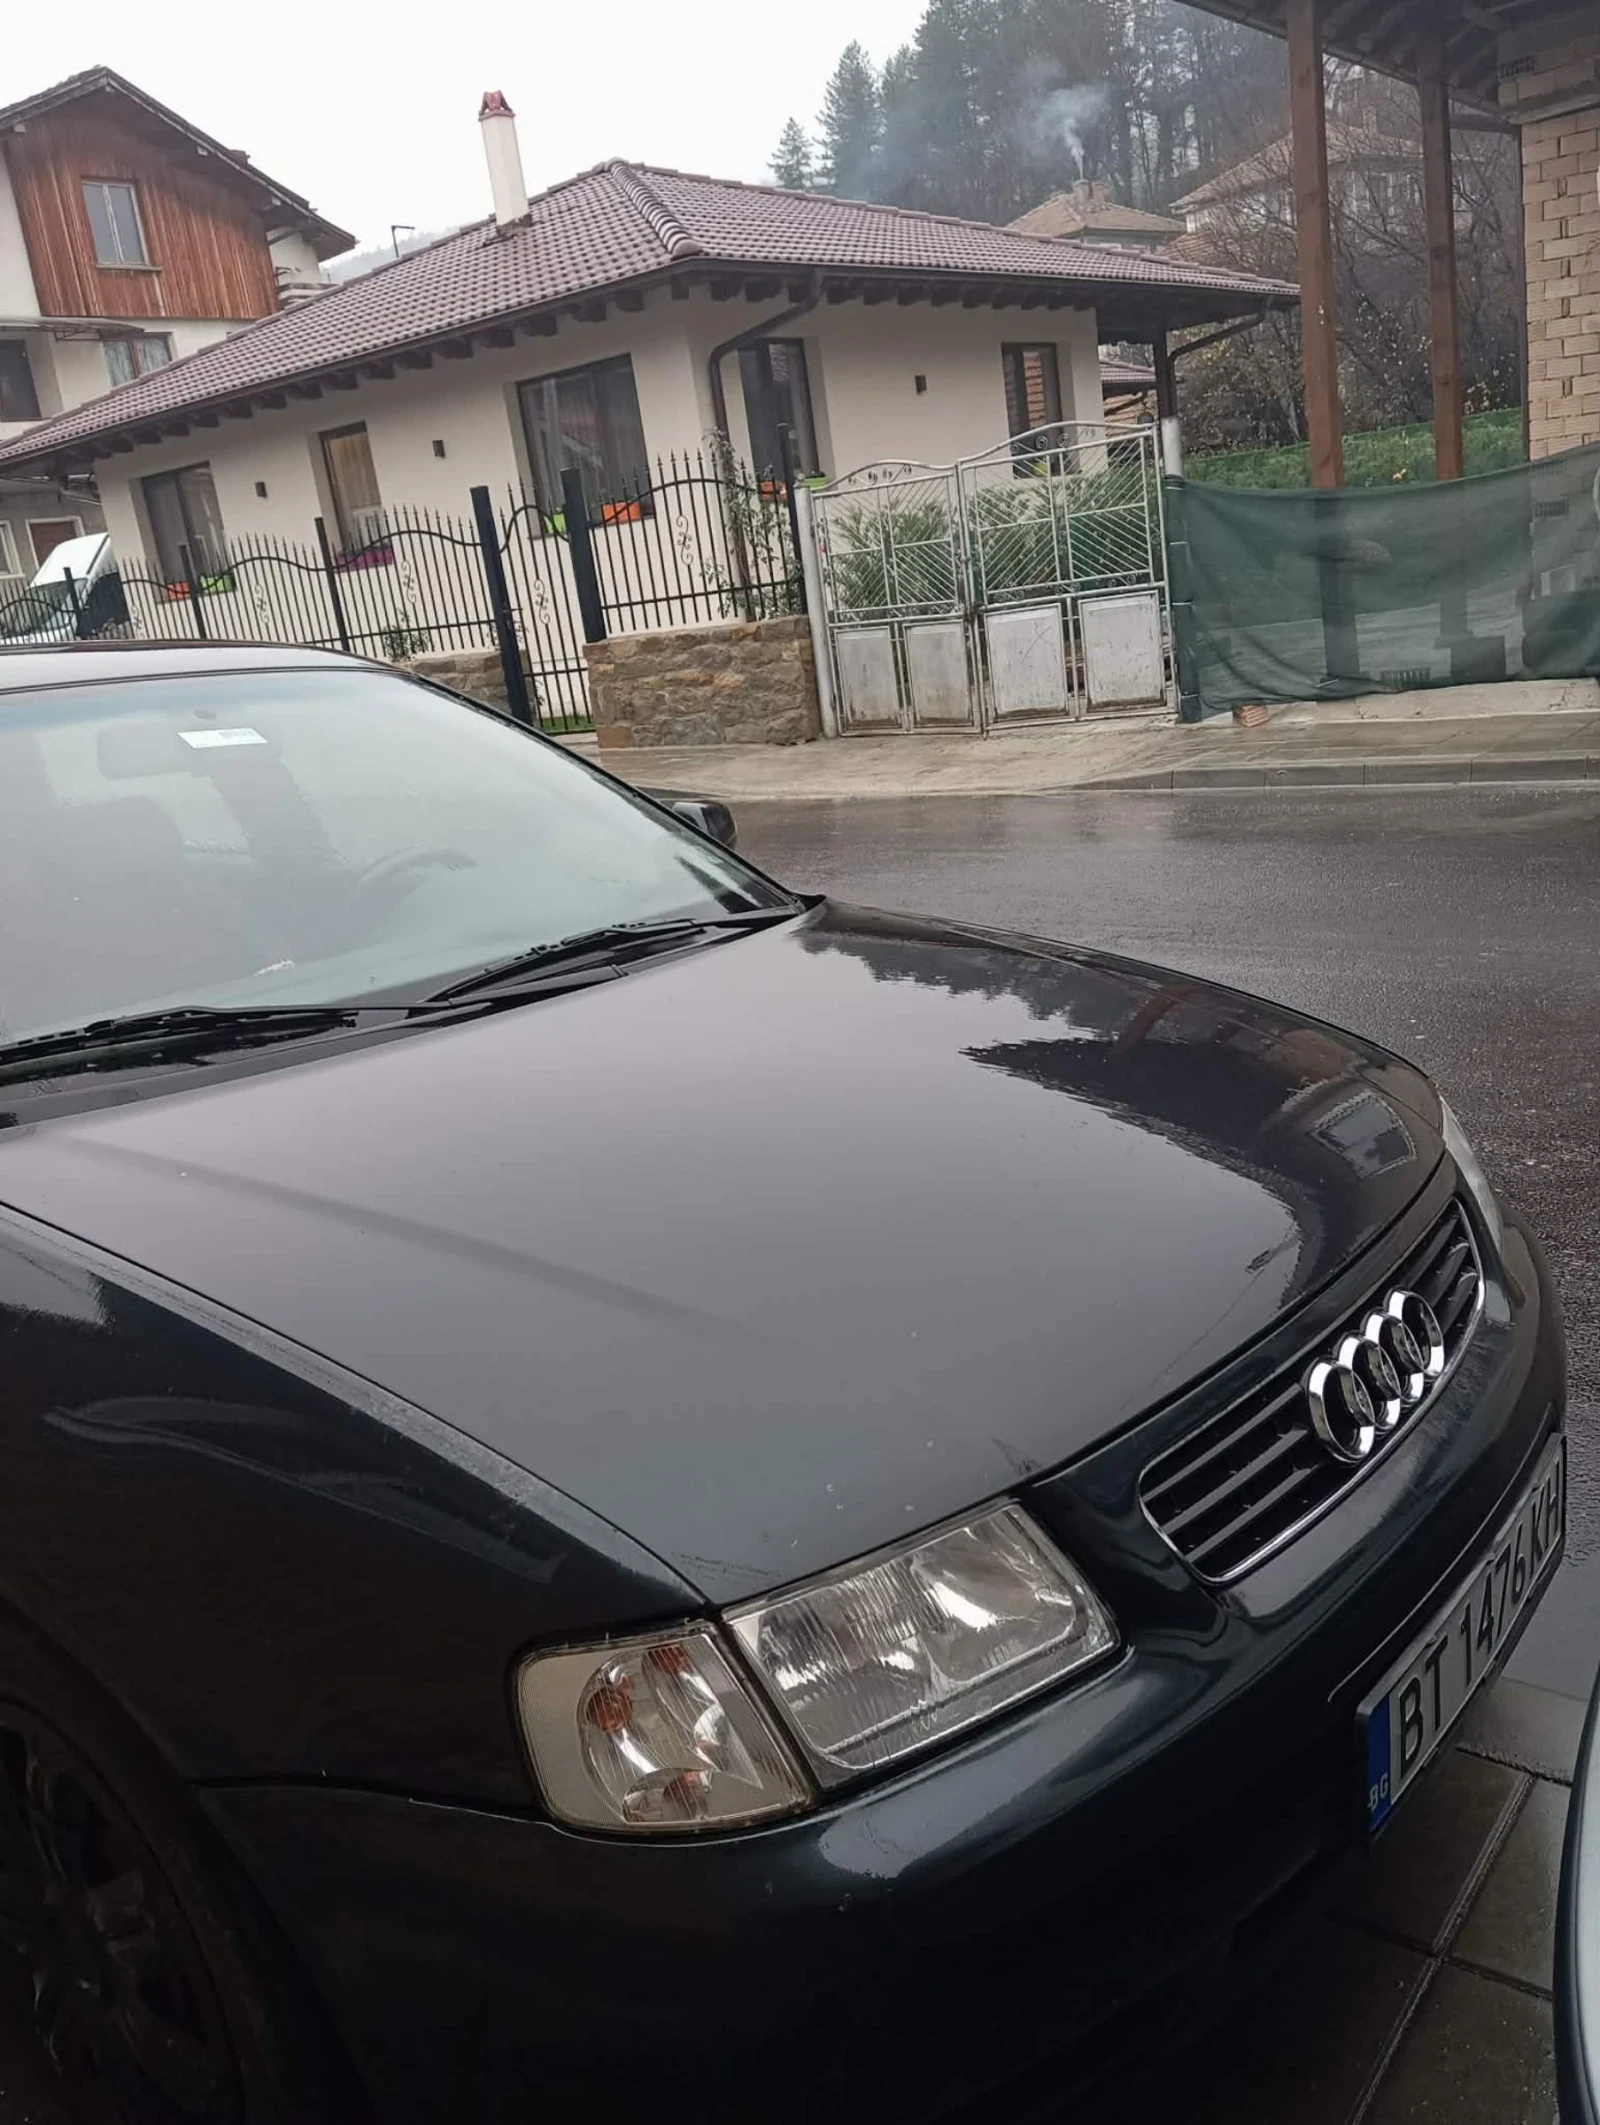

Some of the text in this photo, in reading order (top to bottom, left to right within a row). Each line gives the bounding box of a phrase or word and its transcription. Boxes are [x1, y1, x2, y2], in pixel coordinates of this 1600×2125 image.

[1399, 1458, 1560, 1778] BT 1476 KH
[1368, 1772, 1389, 1810] BG
